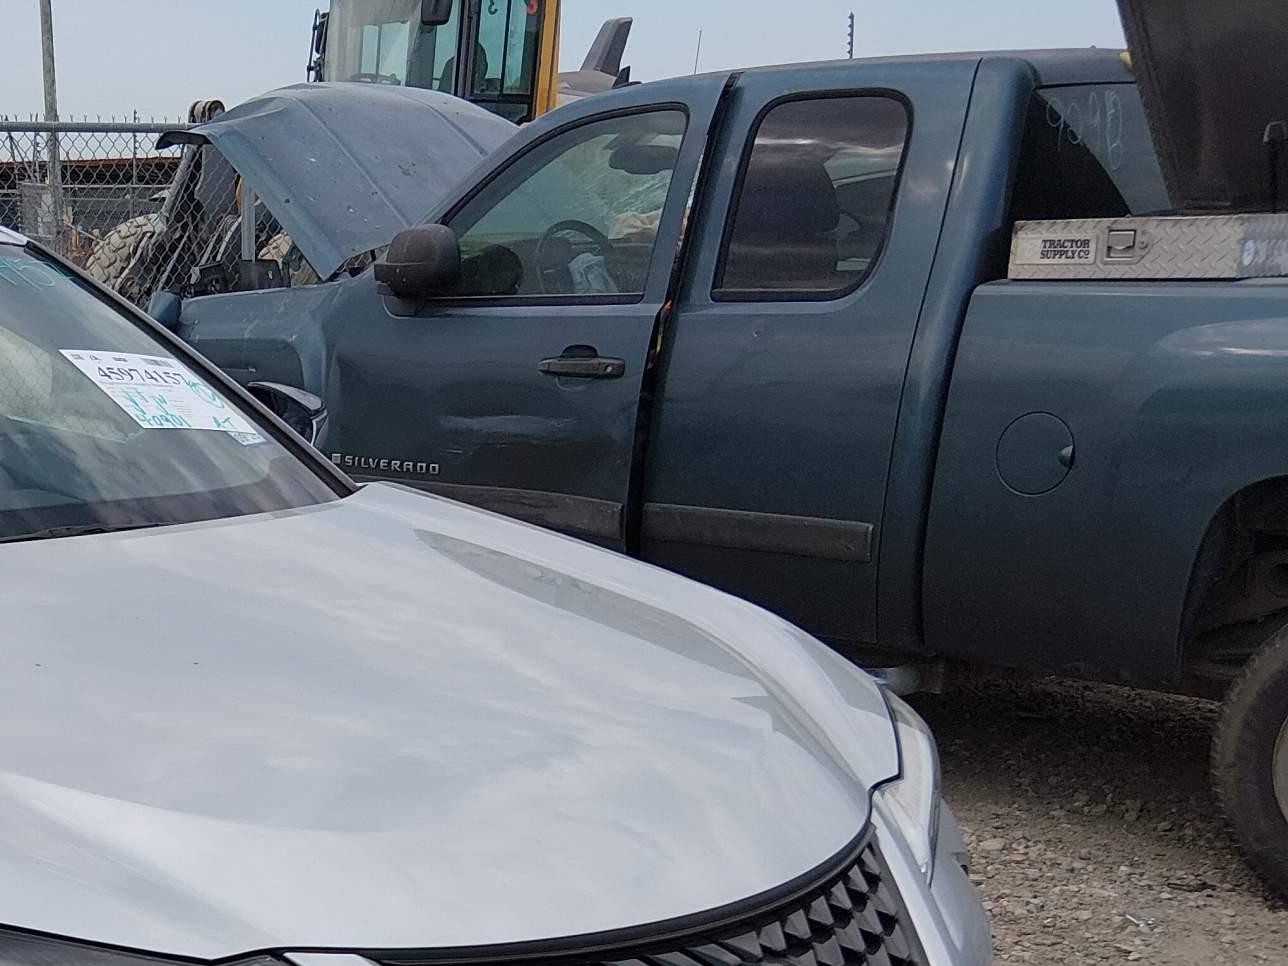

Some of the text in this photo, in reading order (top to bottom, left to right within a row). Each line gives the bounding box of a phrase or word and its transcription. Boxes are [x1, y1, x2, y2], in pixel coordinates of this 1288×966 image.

[1040, 239, 1091, 249] TRACTOR
[1039, 249, 1077, 260] SUPPLY
[96, 366, 188, 386] 45974157
[344, 455, 440, 475] SILVERADO
